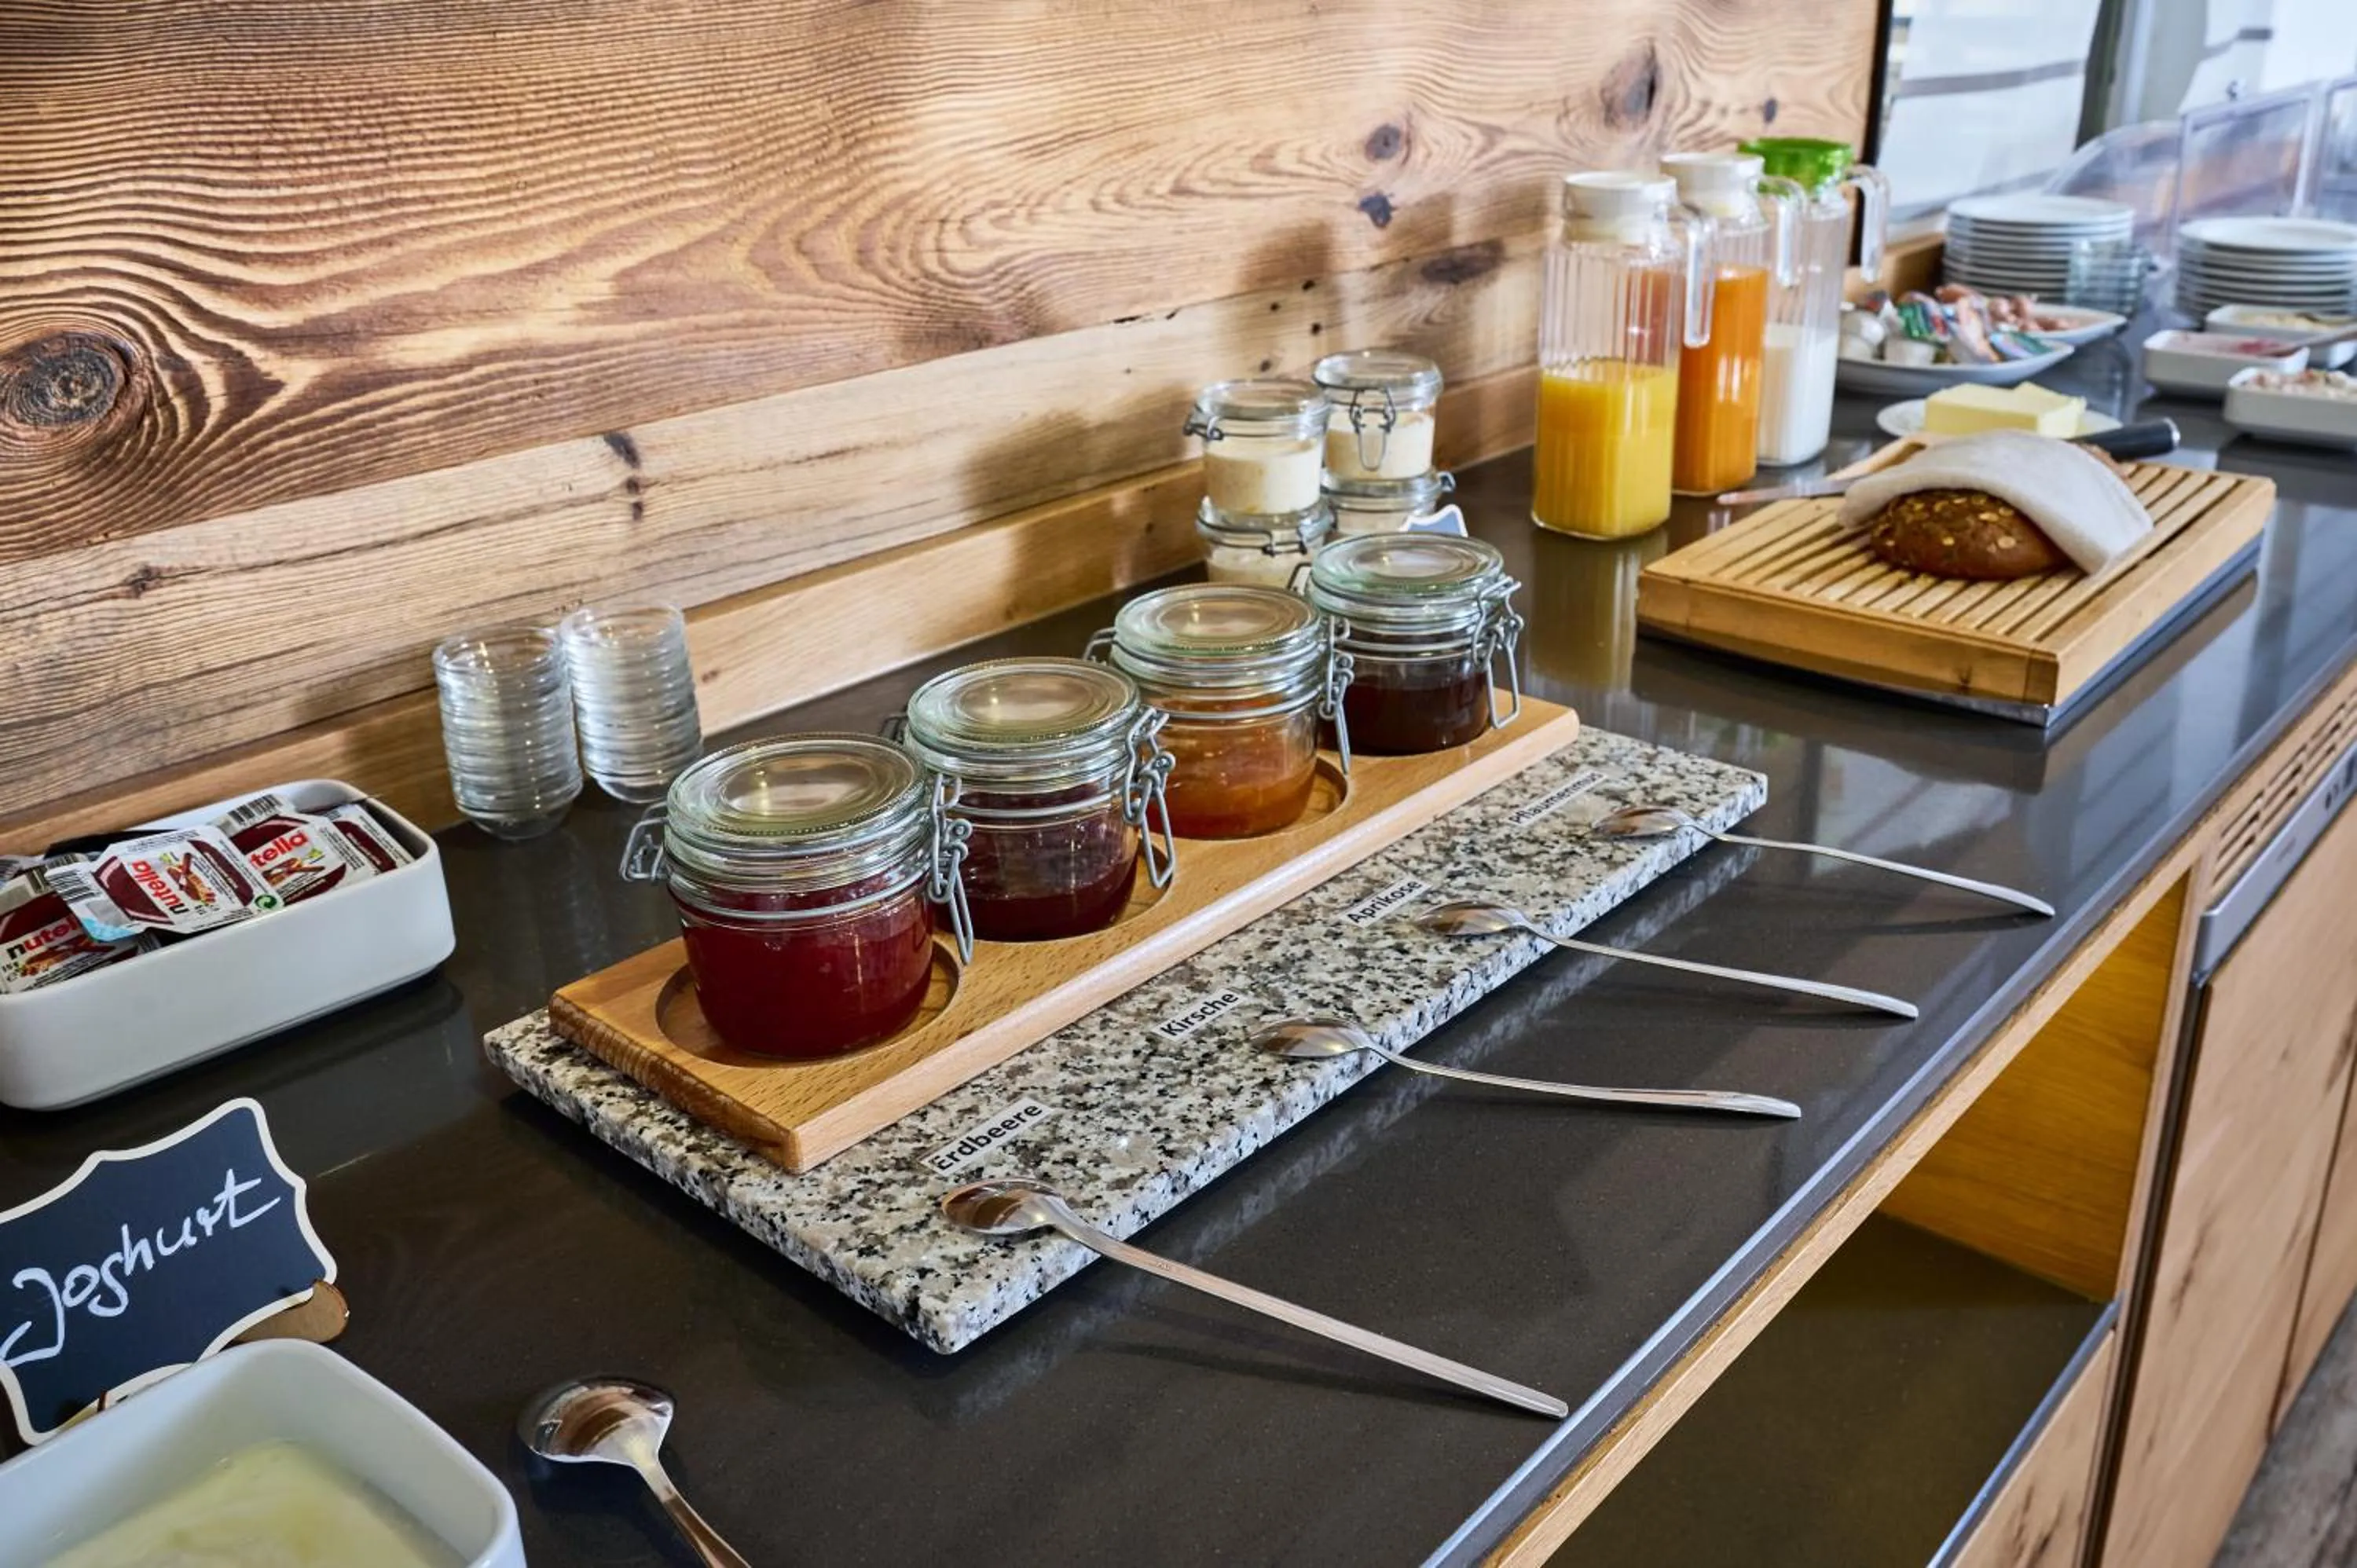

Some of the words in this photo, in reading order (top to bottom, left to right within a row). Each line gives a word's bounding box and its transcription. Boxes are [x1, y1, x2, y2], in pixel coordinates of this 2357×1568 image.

[249, 830, 310, 867] tella
[131, 859, 189, 914] nutella
[1347, 881, 1422, 923] Aprikose
[6, 914, 79, 960] nutel
[1160, 994, 1239, 1036] Kirsche
[929, 1105, 1043, 1171] Erdbeere
